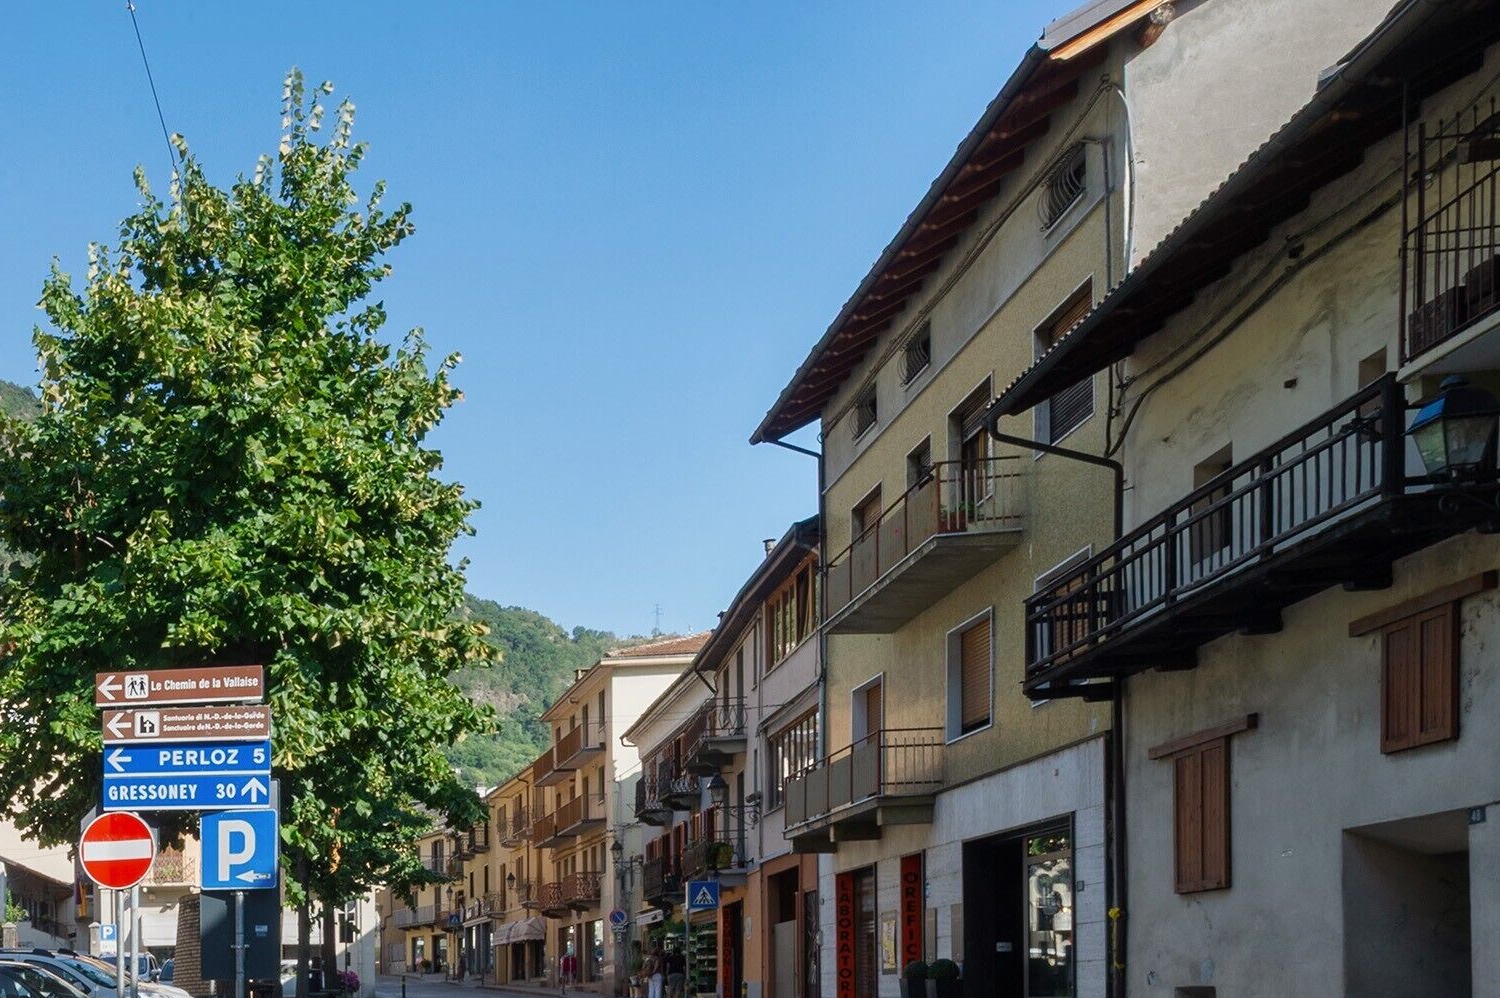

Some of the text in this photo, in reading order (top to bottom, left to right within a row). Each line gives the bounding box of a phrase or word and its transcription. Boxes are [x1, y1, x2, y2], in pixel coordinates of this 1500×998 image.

[150, 676, 259, 691] Le Chemin de la Vallaise
[159, 748, 266, 766] PERLOZ 5
[108, 783, 236, 801] GRESSONEY 30
[218, 819, 256, 882] P
[904, 872, 918, 962] OREFIC
[103, 926, 114, 939] P
